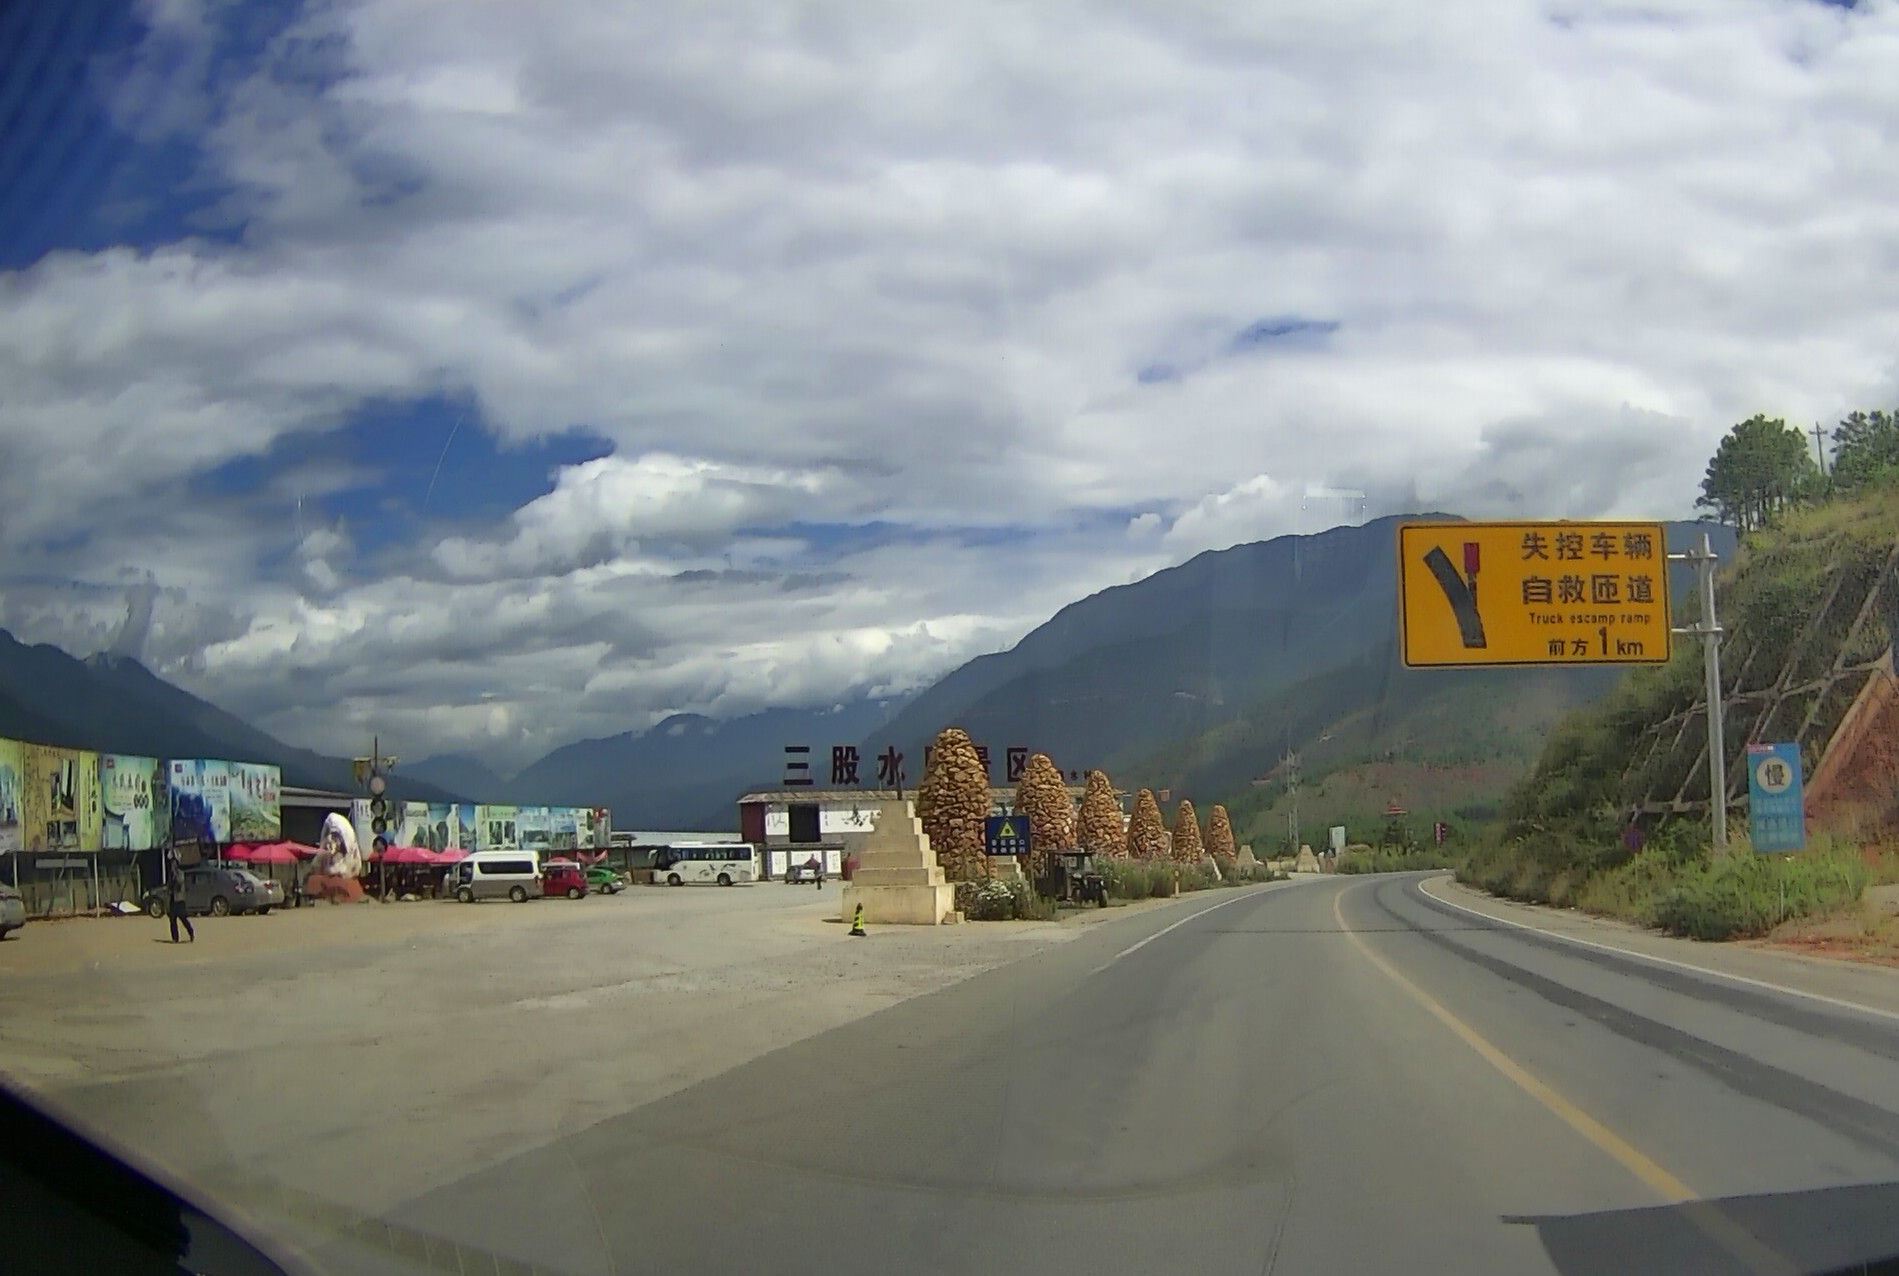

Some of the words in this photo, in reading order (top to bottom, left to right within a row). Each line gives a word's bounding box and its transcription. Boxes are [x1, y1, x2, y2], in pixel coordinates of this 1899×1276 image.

[1521, 532, 1652, 560] 失控车辆
[1522, 573, 1654, 604] 自救匝道
[1529, 612, 1563, 624] Truck
[1620, 613, 1651, 626] ramp
[1548, 638, 1589, 656] 前方
[1599, 626, 1607, 655] 1
[1616, 638, 1643, 656] km
[783, 746, 1028, 786] 三股水区
